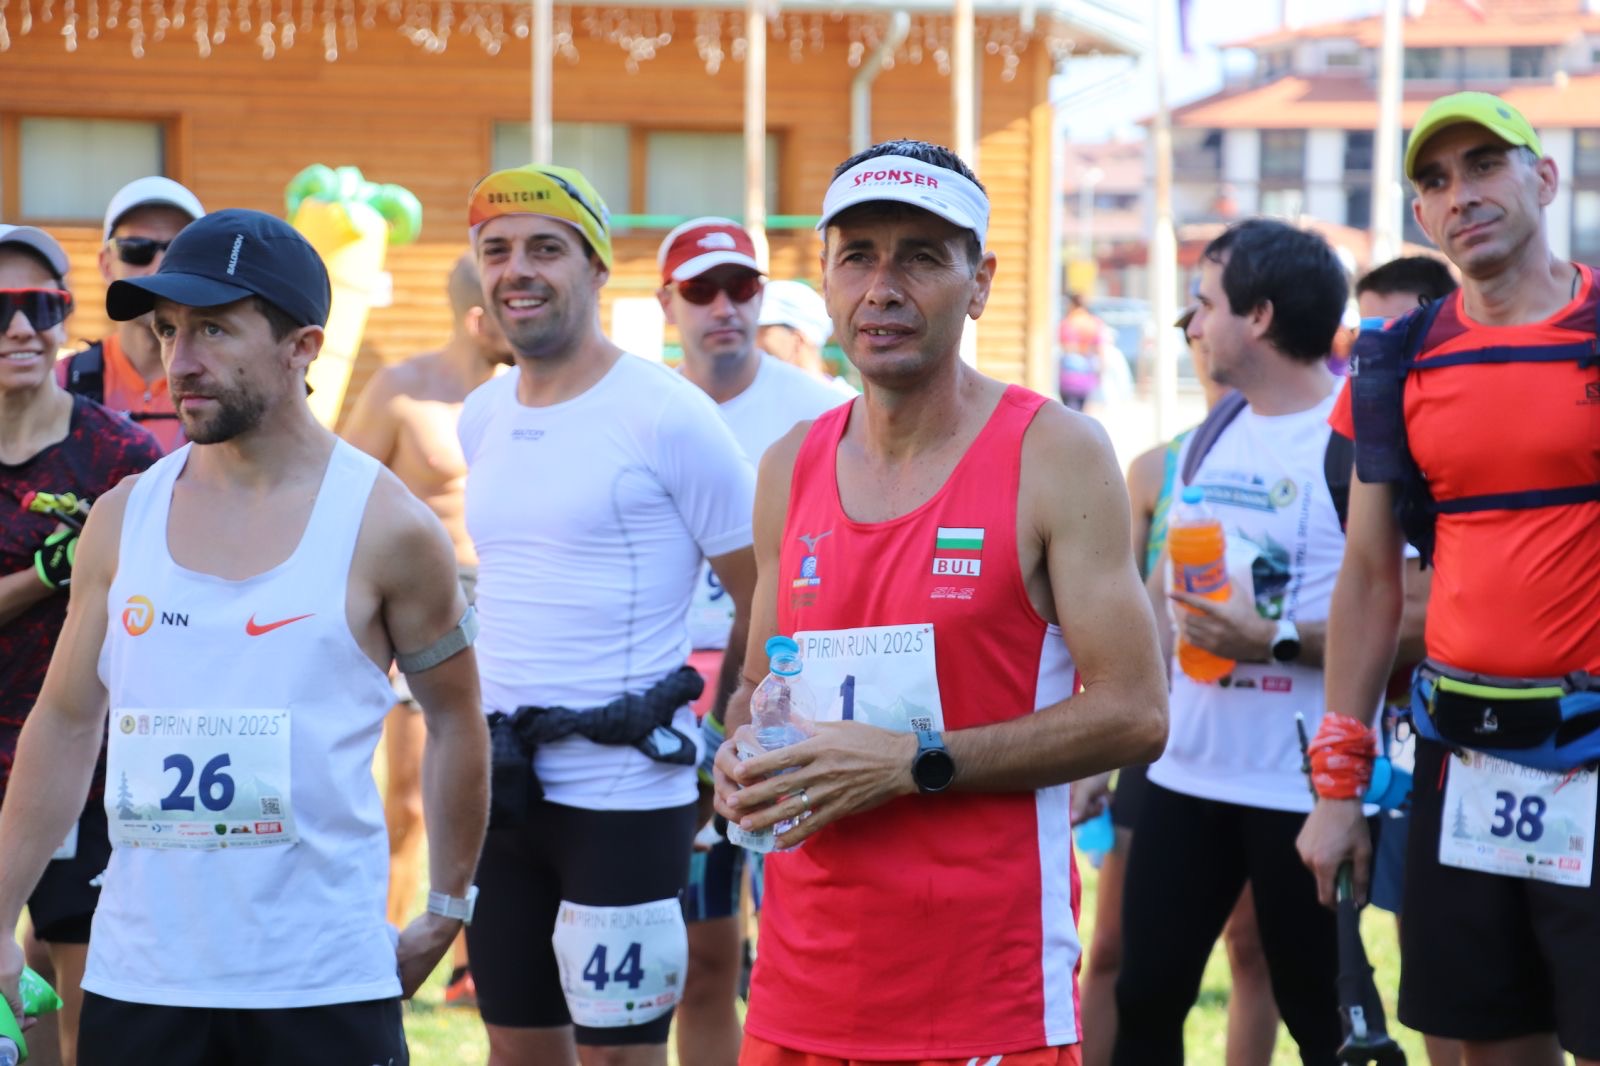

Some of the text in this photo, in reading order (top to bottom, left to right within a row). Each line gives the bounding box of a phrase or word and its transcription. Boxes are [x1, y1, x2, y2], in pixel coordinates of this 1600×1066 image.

[849, 169, 939, 189] SPONSER
[226, 233, 245, 276] SALOMON
[937, 559, 976, 575] BUL
[161, 611, 190, 627] NN
[808, 631, 924, 658] PIRIN RUN 2025
[839, 674, 856, 720] 1
[153, 715, 280, 737] PIRIN RUN 2025
[160, 753, 235, 812] 26
[1490, 790, 1547, 842] 38
[583, 942, 645, 990] 44
